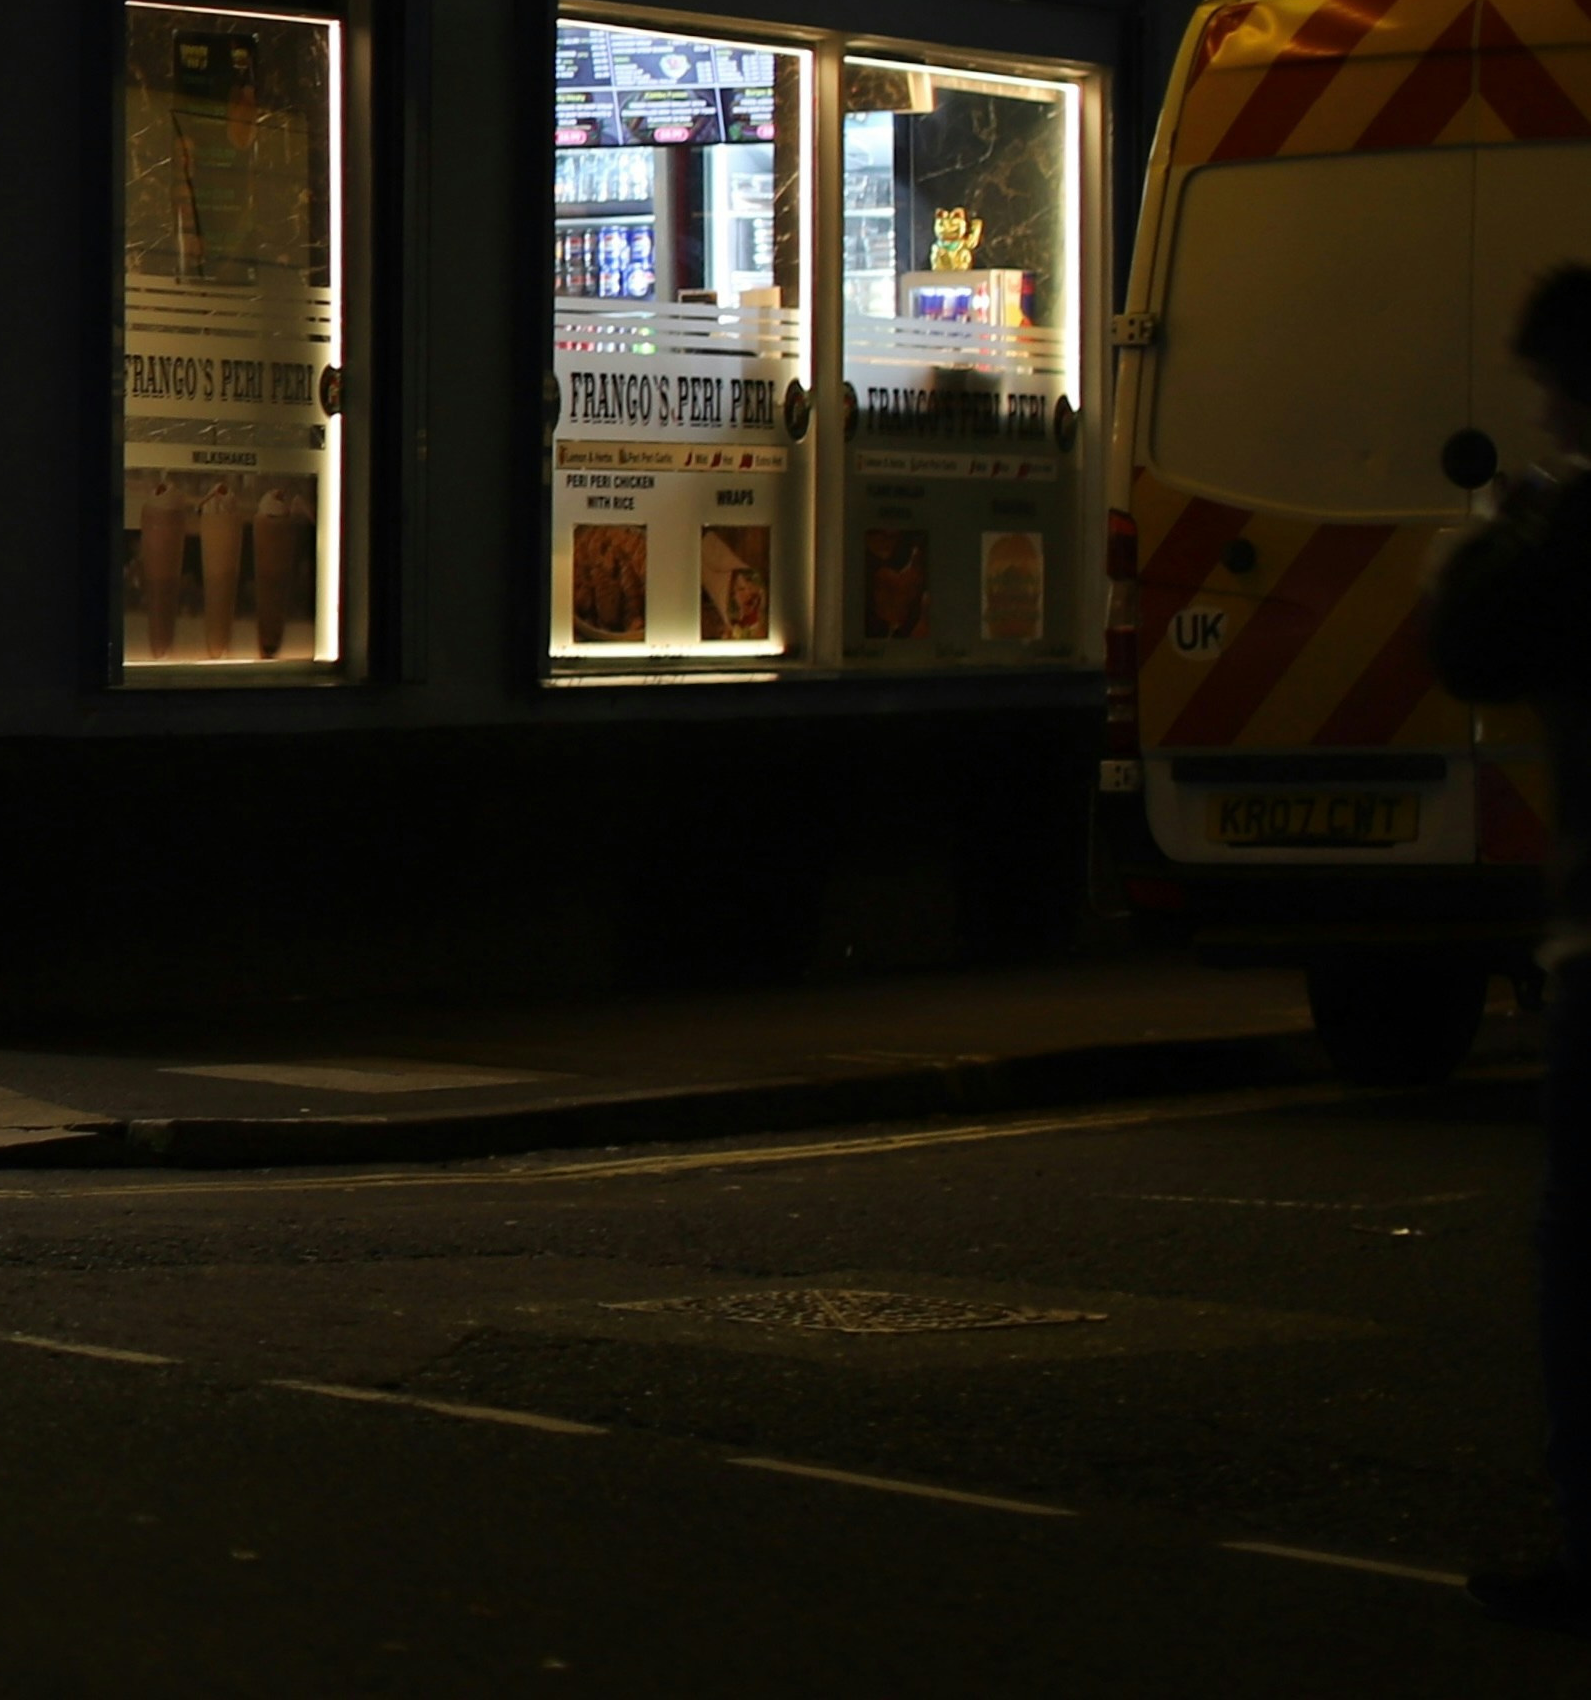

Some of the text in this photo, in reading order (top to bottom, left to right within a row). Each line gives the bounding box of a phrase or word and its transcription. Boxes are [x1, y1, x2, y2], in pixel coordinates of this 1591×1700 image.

[220, 359, 264, 403] PERI
[270, 362, 315, 405] PERI
[570, 372, 776, 429] FRANGO'S PERI PERI
[567, 474, 655, 490] PERI PERI CHICKEN
[587, 496, 636, 511] WITH RICE
[717, 489, 755, 506] WRAPS
[1176, 612, 1225, 651] UK
